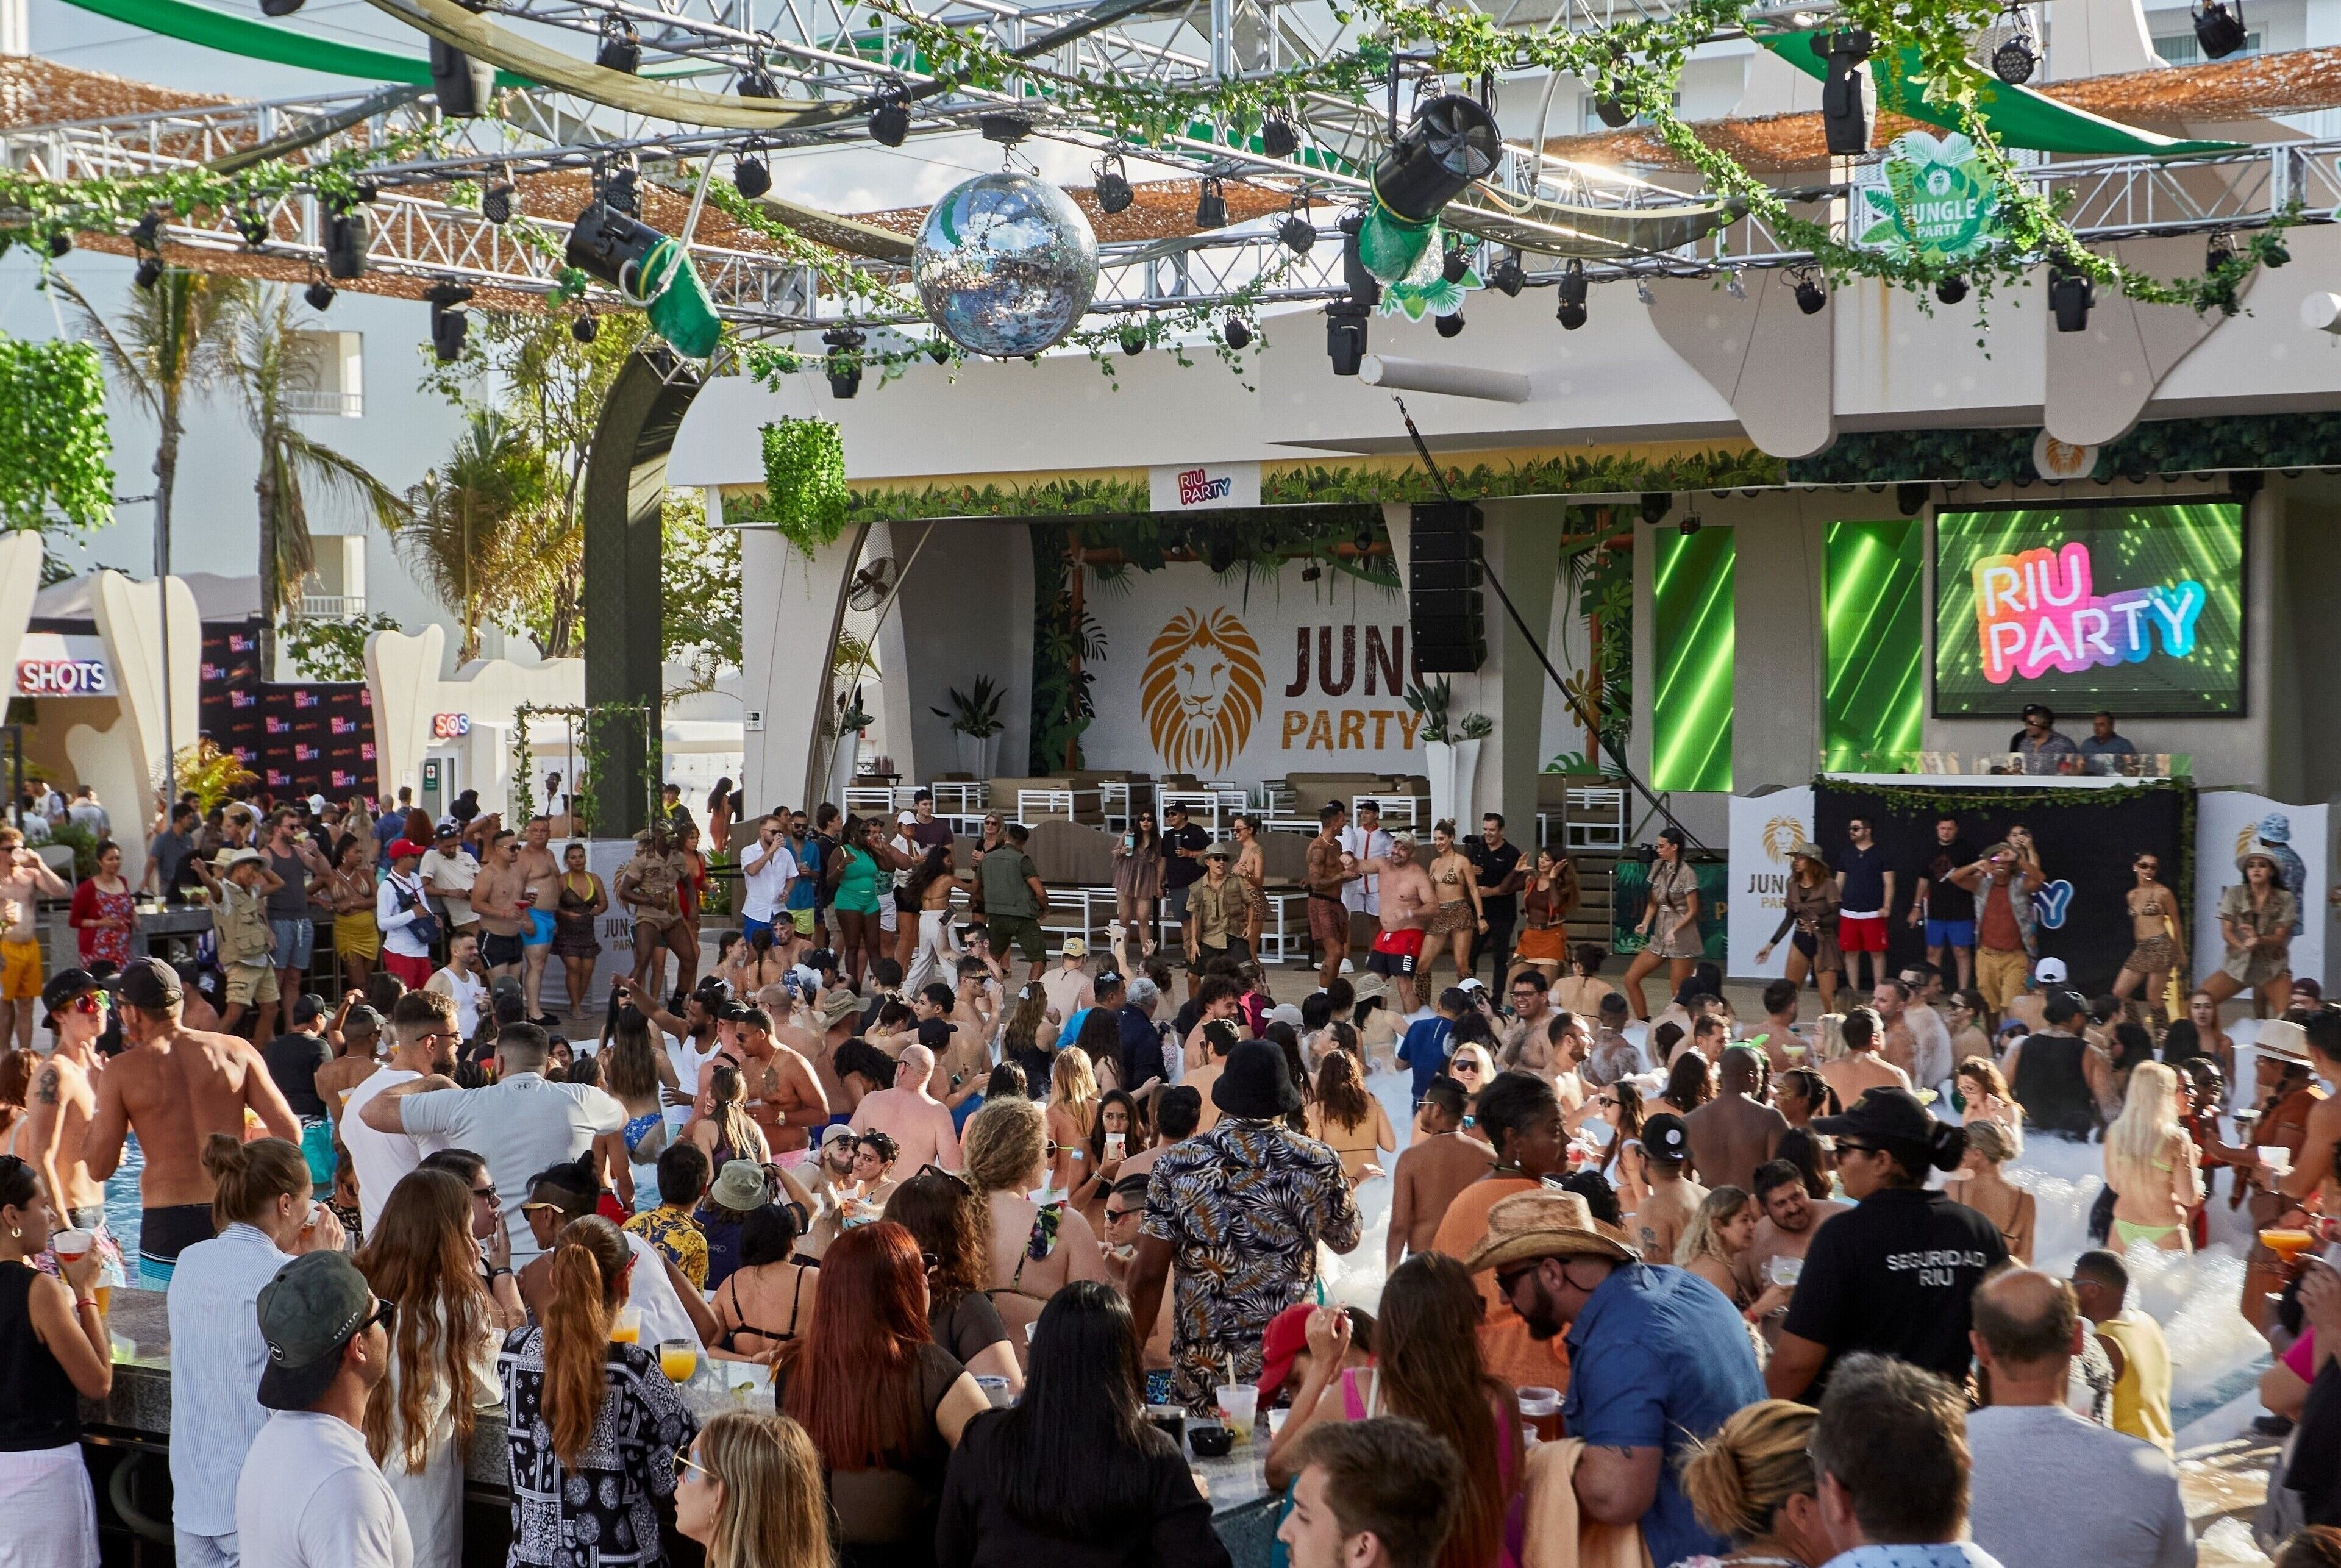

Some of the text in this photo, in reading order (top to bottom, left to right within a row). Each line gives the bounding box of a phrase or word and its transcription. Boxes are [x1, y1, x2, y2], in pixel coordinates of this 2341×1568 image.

[1916, 223, 1961, 238] PARTY
[1180, 471, 1203, 488] RIU
[1183, 480, 1229, 502] PARTY
[1984, 554, 2083, 617] RIU
[1989, 587, 2193, 672] PARTY
[1285, 625, 1425, 697] JUN
[23, 662, 107, 691] SHOTS
[435, 714, 469, 736] SOS
[1281, 709, 1425, 750] PARTY
[1748, 874, 1784, 894] JUN
[1762, 897, 1786, 909] PAR
[604, 918, 628, 938] JUN
[613, 940, 632, 951] PAR
[1886, 1250, 1986, 1271] SEGURIDAD
[1919, 1267, 1954, 1286] RIU
